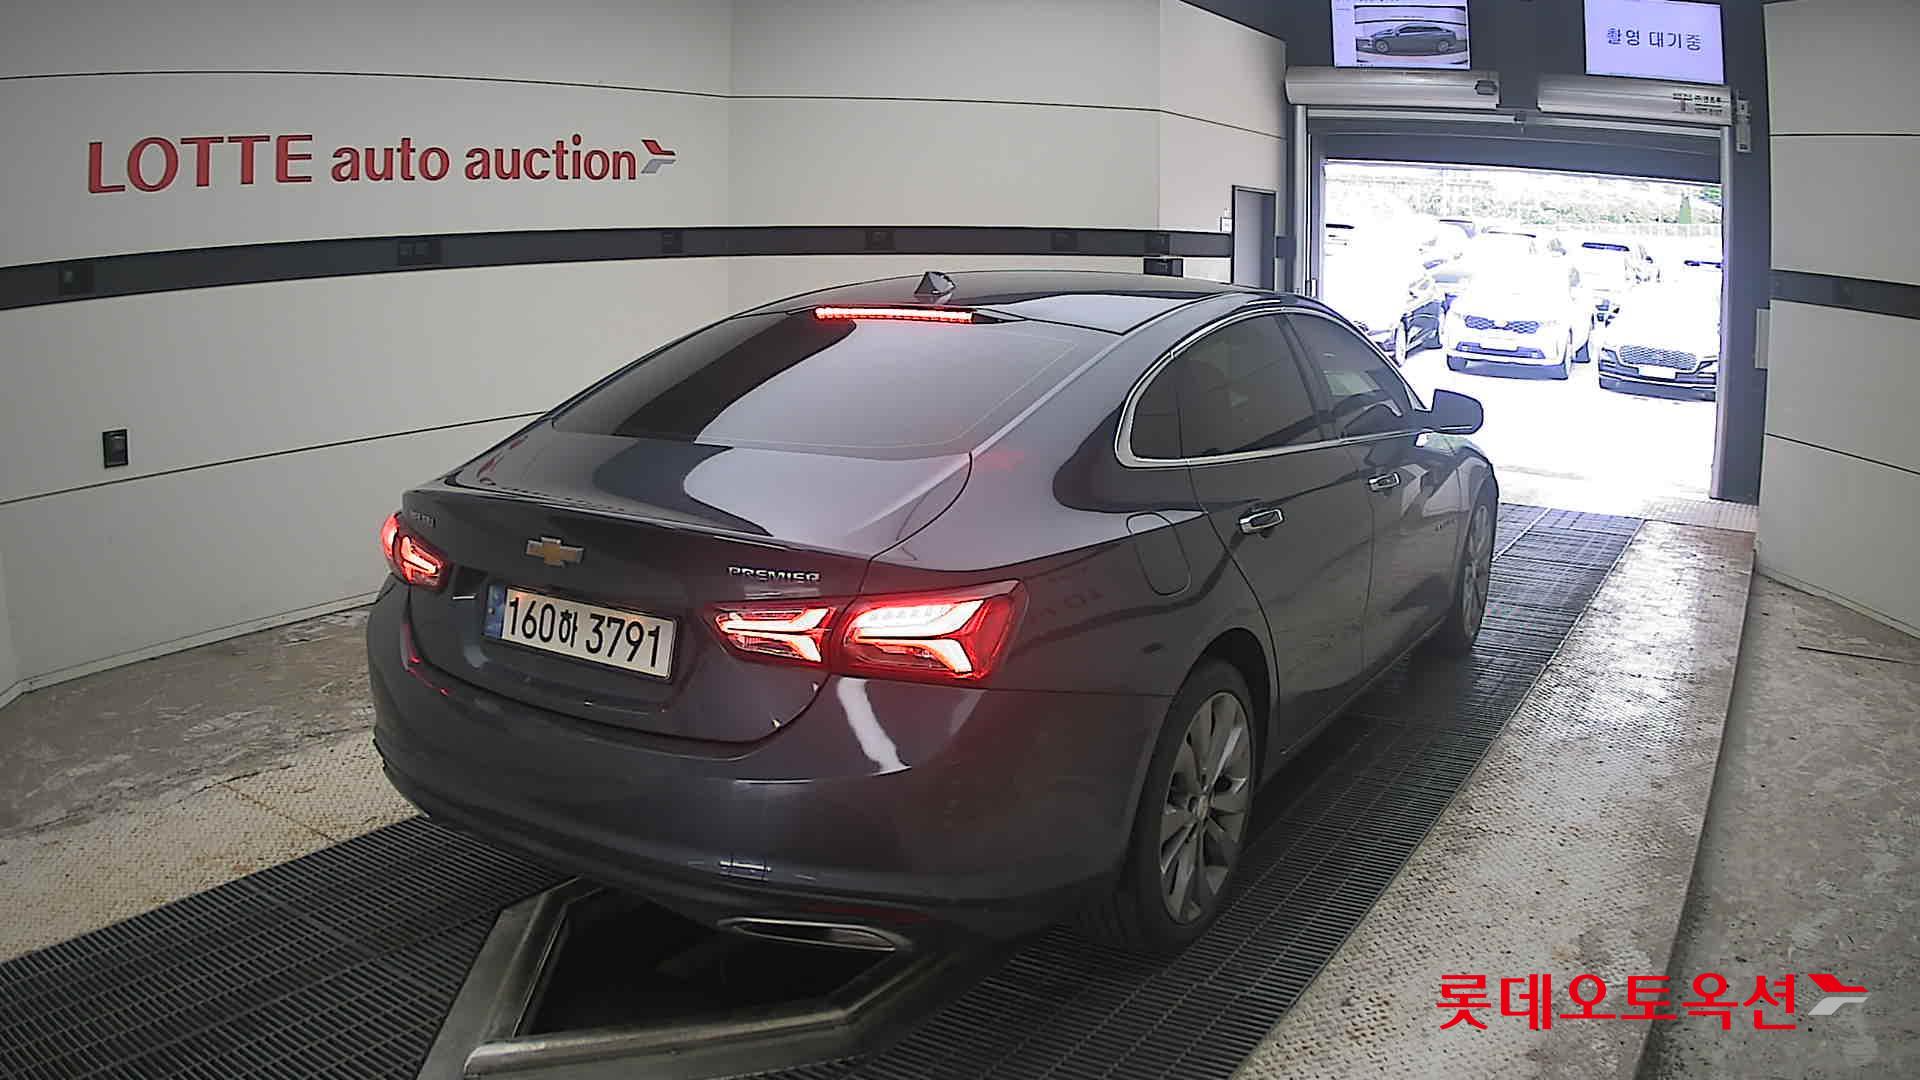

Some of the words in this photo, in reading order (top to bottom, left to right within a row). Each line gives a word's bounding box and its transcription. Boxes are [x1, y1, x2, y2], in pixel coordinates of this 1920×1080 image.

[1649, 31, 1701, 51] 대기중
[89, 135, 312, 193] LOTTE
[331, 137, 450, 181] auto
[465, 134, 637, 180] auction
[728, 566, 820, 583] PREMIER
[509, 597, 578, 648] 160하
[585, 613, 661, 668] 3791
